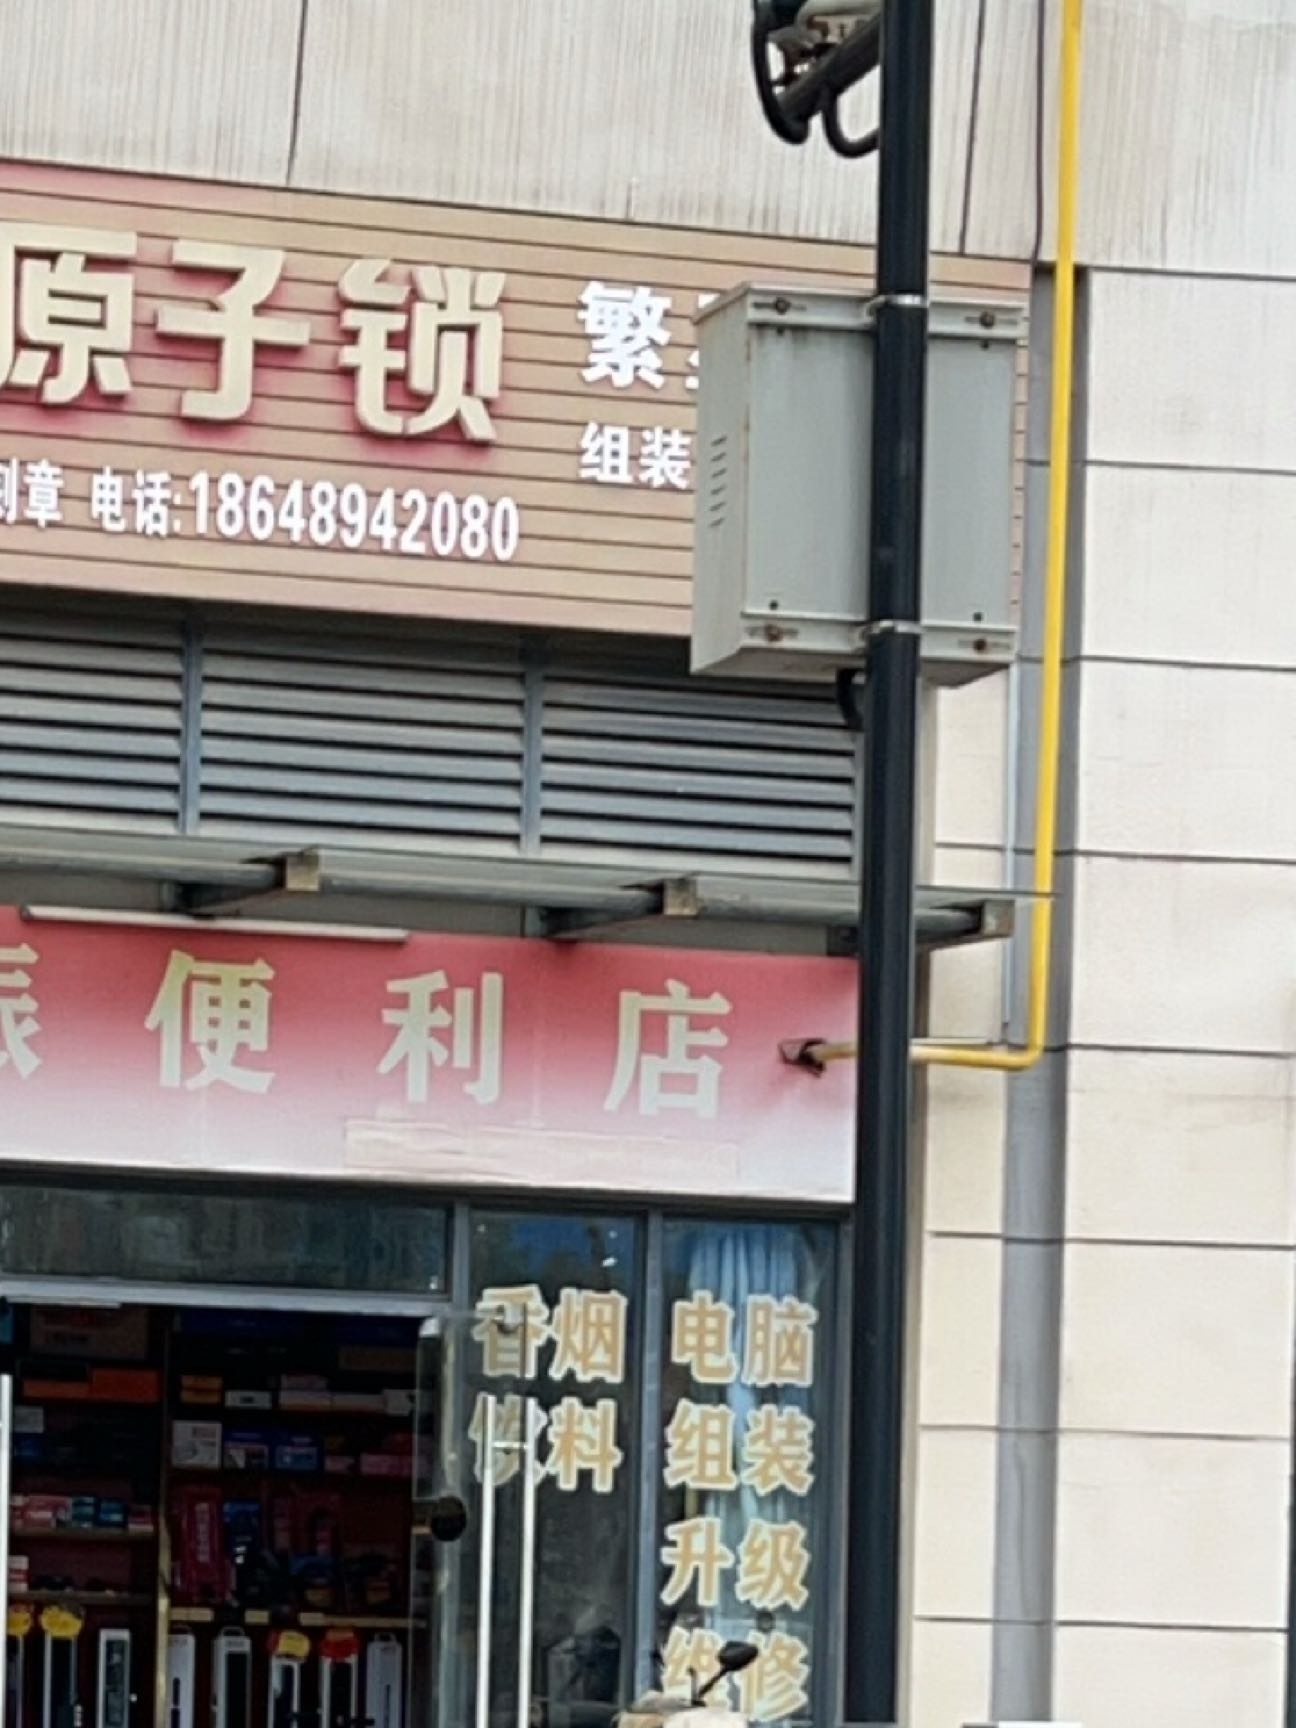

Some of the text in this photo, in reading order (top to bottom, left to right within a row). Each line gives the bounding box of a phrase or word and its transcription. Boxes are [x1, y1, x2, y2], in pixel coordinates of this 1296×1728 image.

[577, 280, 718, 390] 繁
[578, 421, 693, 490] 组装
[471, 1284, 628, 1384] 香烟
[671, 1289, 818, 1388] 电脑
[664, 1398, 815, 1496] 组装
[660, 1517, 811, 1612] 升级
